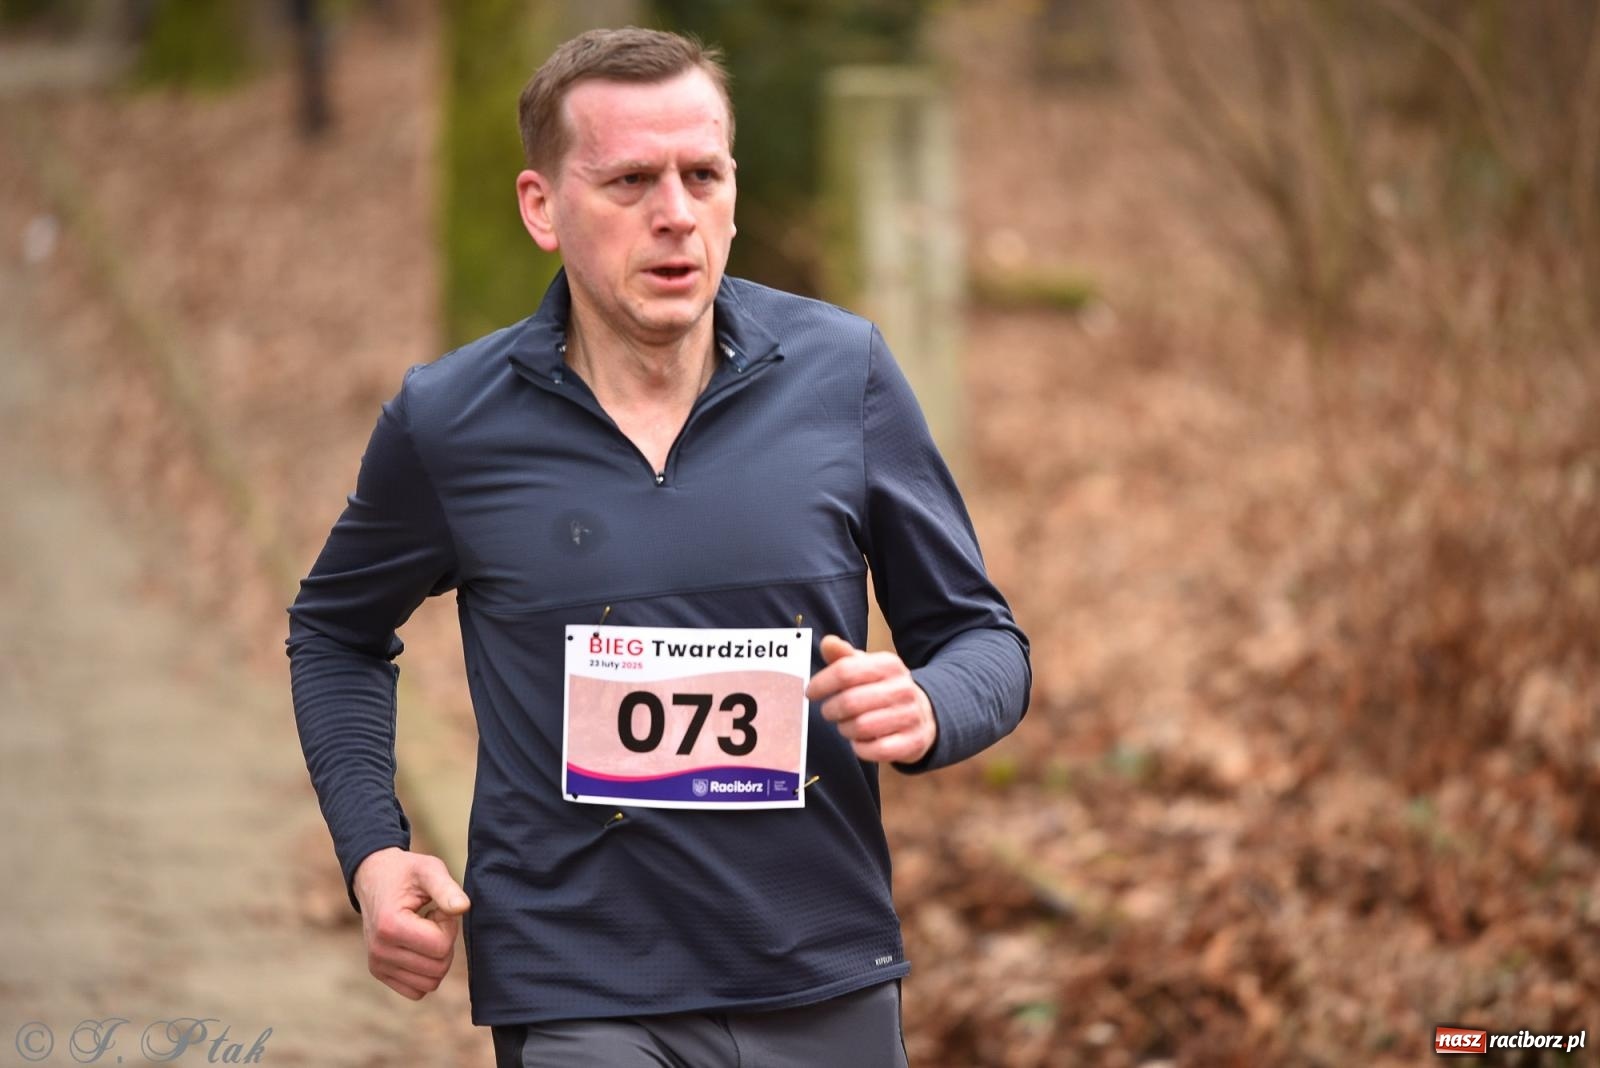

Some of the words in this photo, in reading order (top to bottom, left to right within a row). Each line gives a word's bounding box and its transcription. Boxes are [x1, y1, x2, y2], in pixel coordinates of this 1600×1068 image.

[589, 636, 644, 656] BIEG
[652, 639, 789, 658] Twardziela
[601, 660, 620, 670] luty
[617, 691, 758, 756] 073
[710, 781, 763, 793] Racibórz
